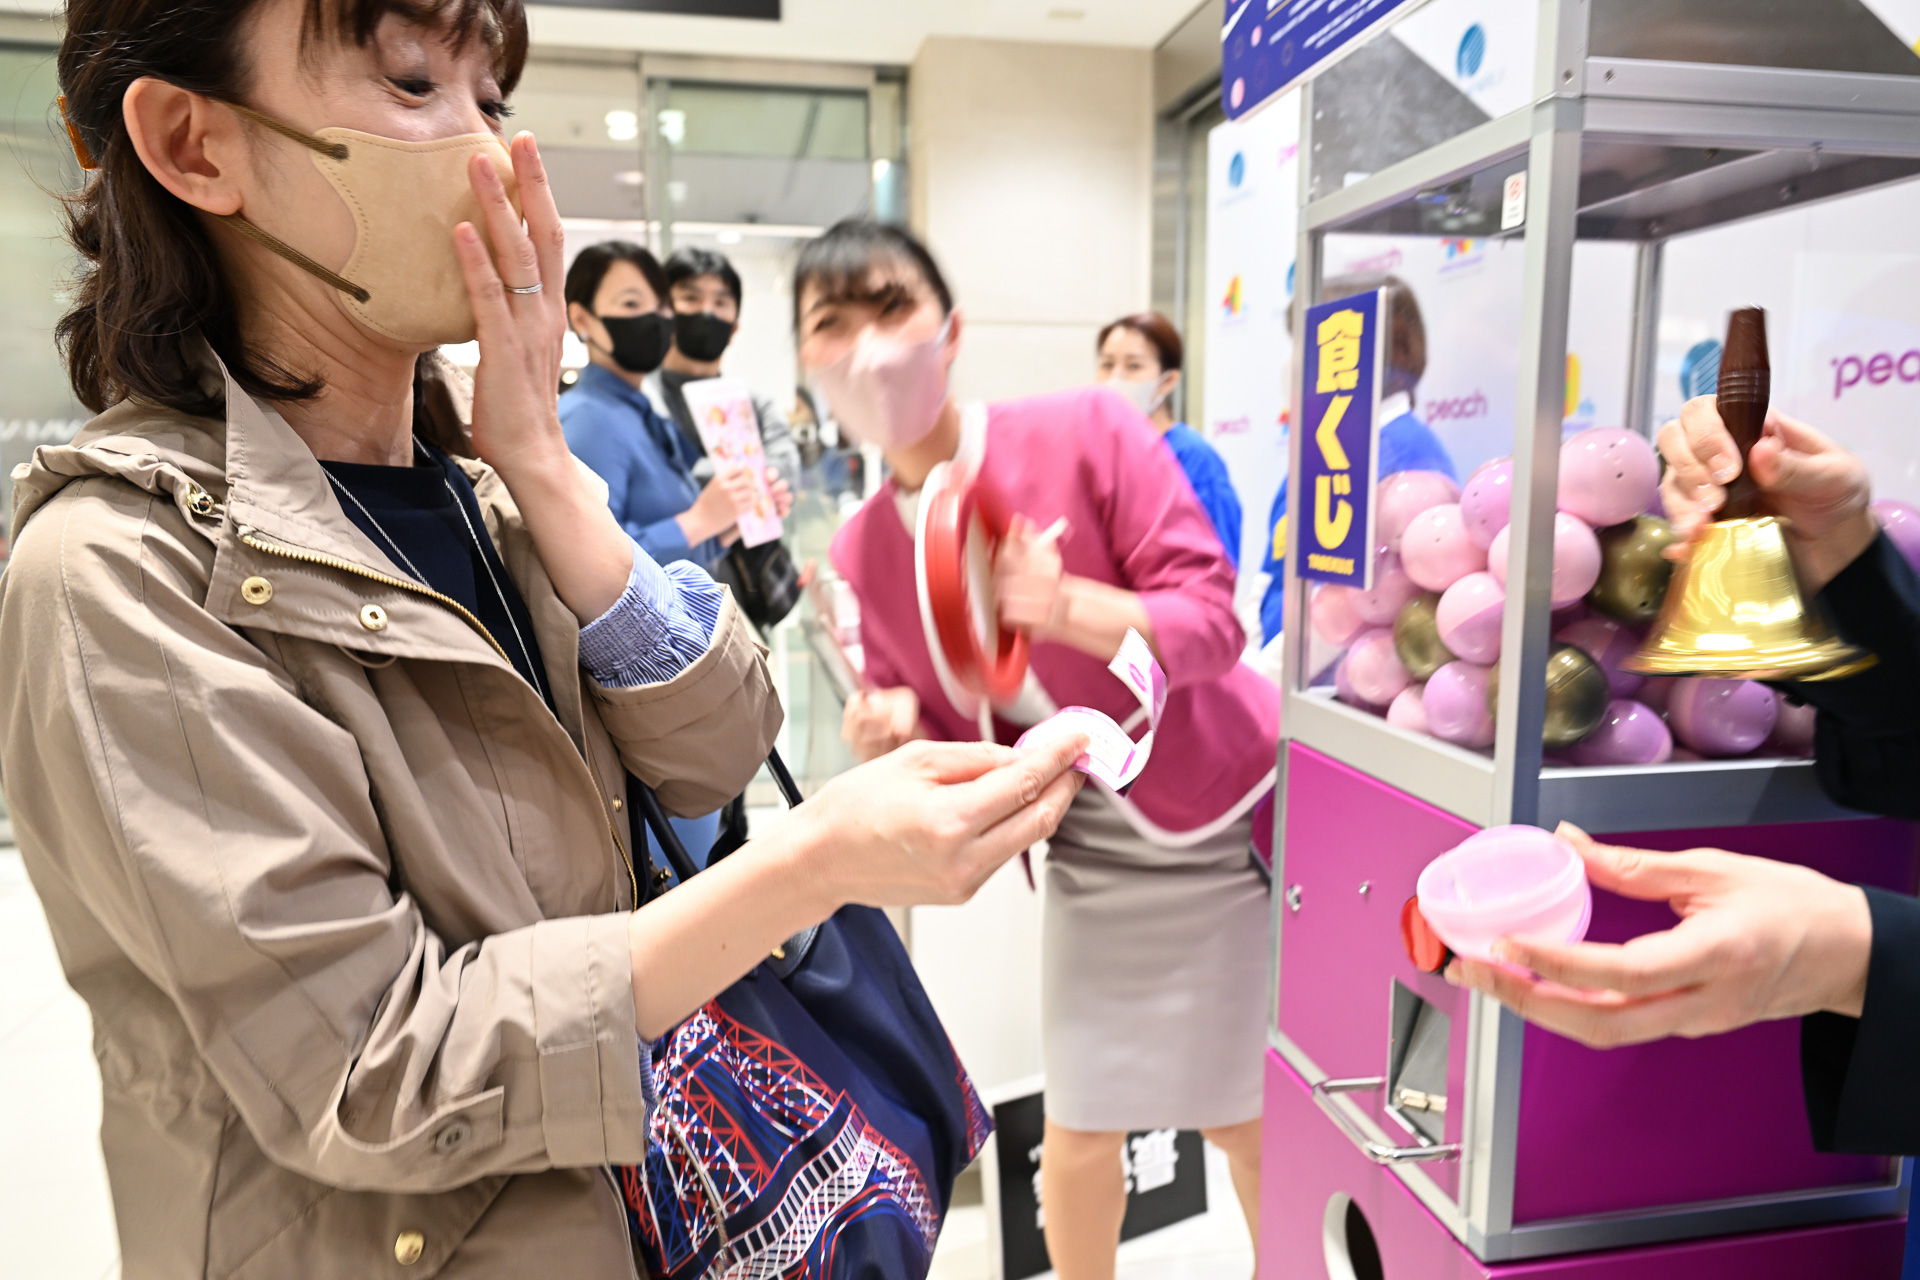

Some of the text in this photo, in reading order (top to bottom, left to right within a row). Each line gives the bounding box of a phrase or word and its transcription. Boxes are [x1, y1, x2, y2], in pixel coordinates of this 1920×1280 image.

[1315, 308, 1364, 550] 食くじ
[1425, 387, 1488, 423] peach
